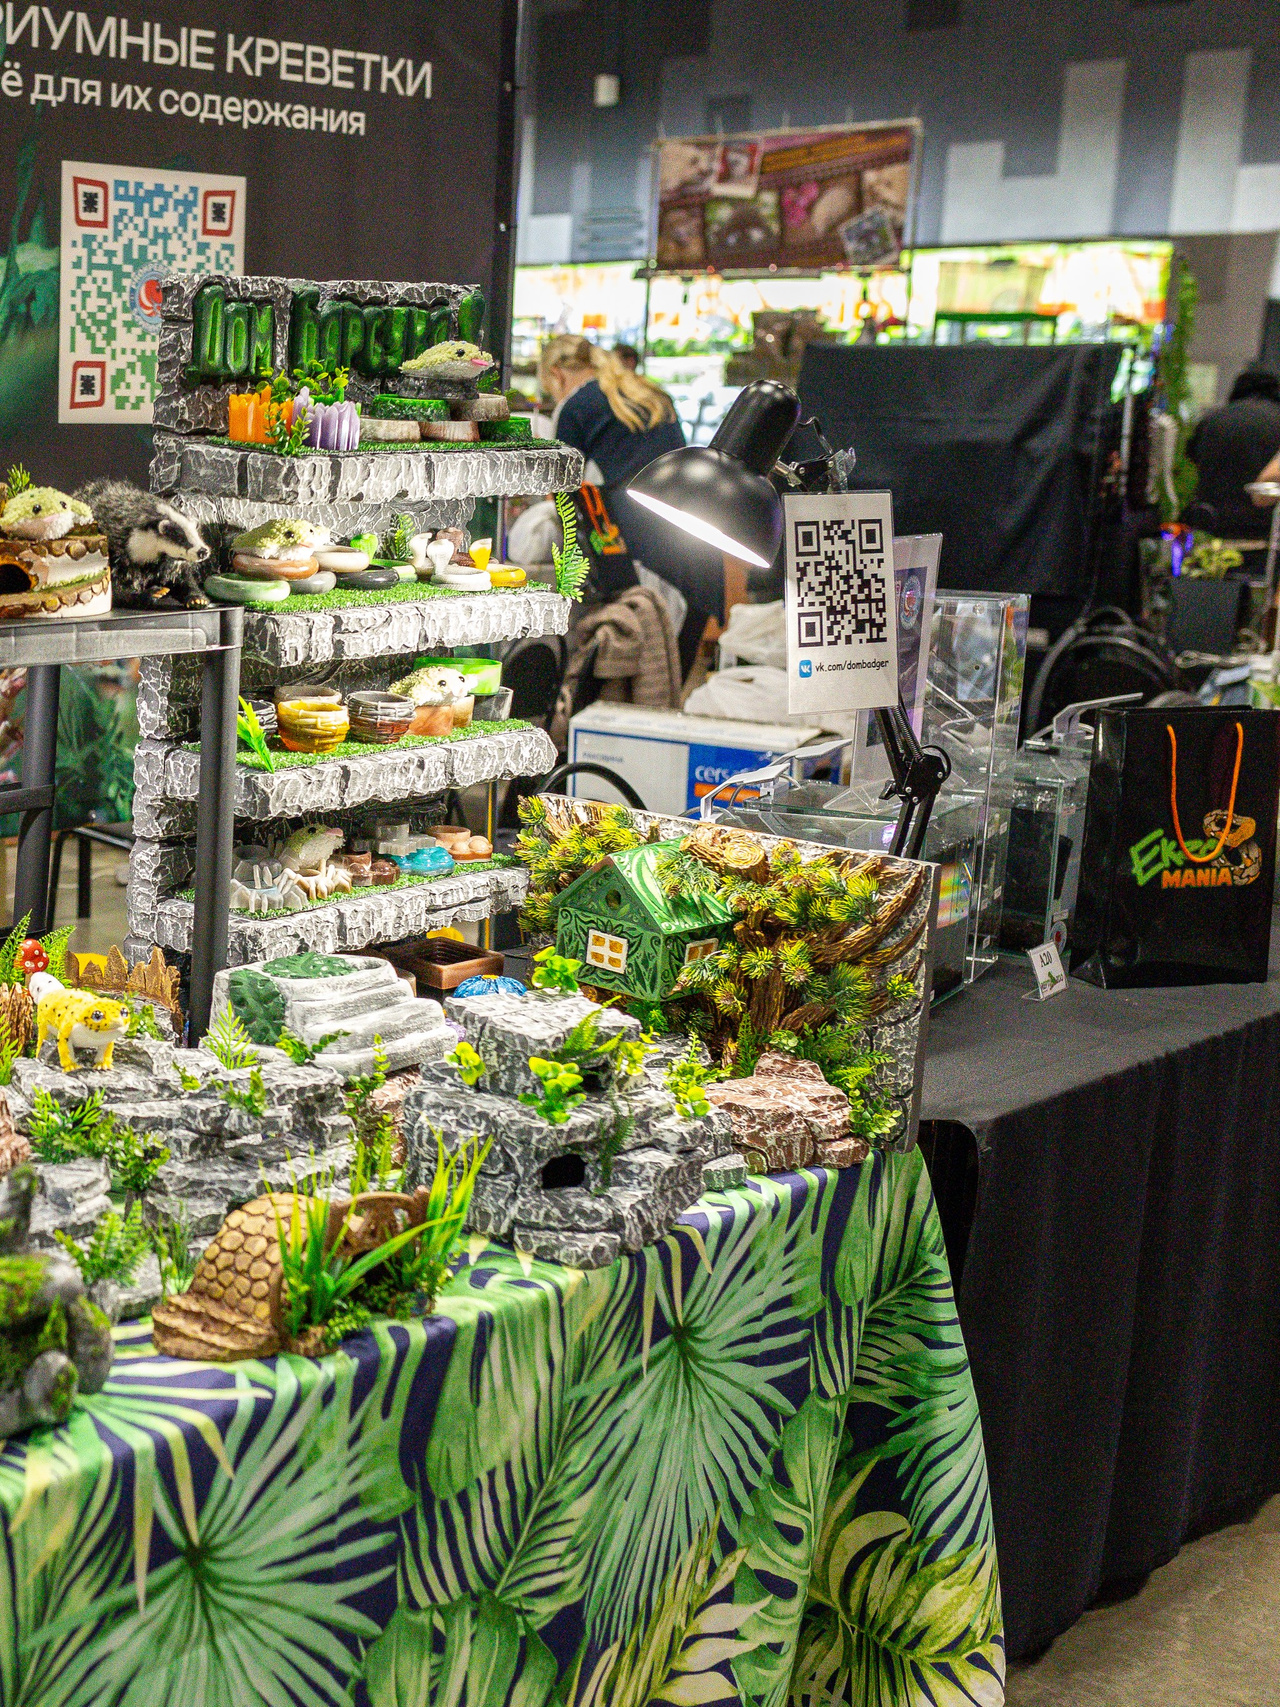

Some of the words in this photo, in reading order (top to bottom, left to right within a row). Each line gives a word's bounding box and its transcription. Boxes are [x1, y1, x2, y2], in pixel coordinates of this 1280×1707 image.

[226, 33, 433, 99] КРЕВЕТКИ
[30, 73, 102, 107] для
[111, 82, 152, 112] их
[158, 88, 366, 136] содержания
[815, 659, 890, 673] vk.com/dombadger
[1161, 867, 1233, 889] MANIA
[1039, 950, 1053, 967] A20
